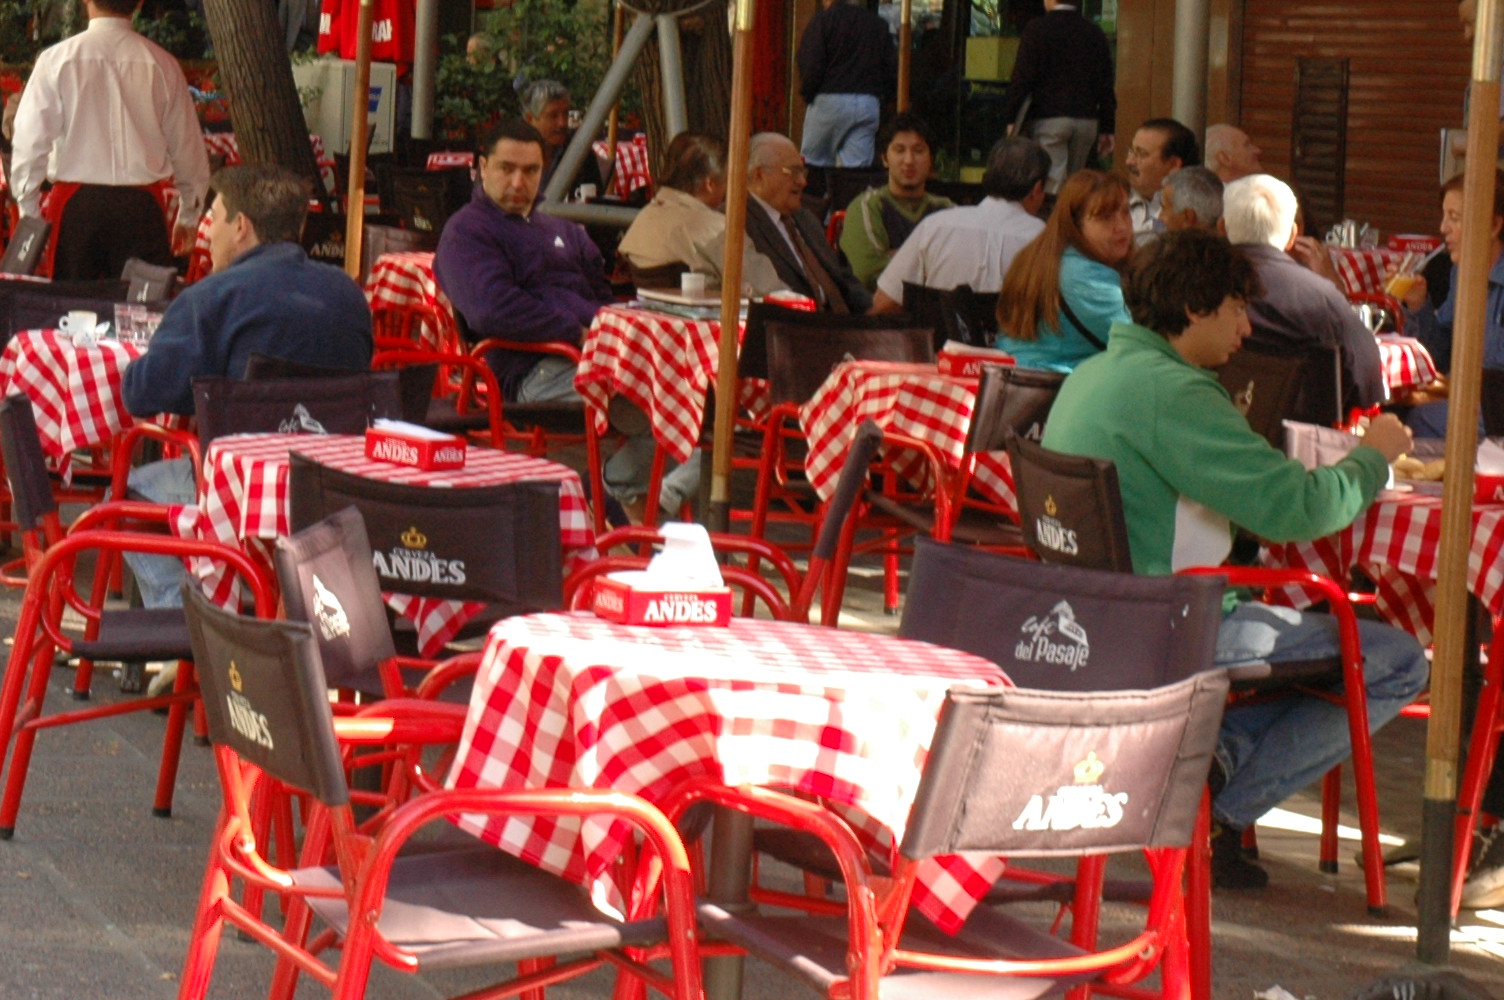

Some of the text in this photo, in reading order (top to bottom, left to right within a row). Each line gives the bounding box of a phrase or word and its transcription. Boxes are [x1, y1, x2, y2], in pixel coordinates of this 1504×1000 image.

[372, 440, 419, 465] ANDES
[433, 448, 464, 464] ANDES
[1037, 517, 1079, 556] ANDES
[372, 549, 467, 586] ANDES
[643, 599, 718, 623] ANDES
[1014, 636, 1089, 672] del Pasaje
[226, 693, 274, 750] ANDES
[1011, 791, 1129, 831] ANDES
